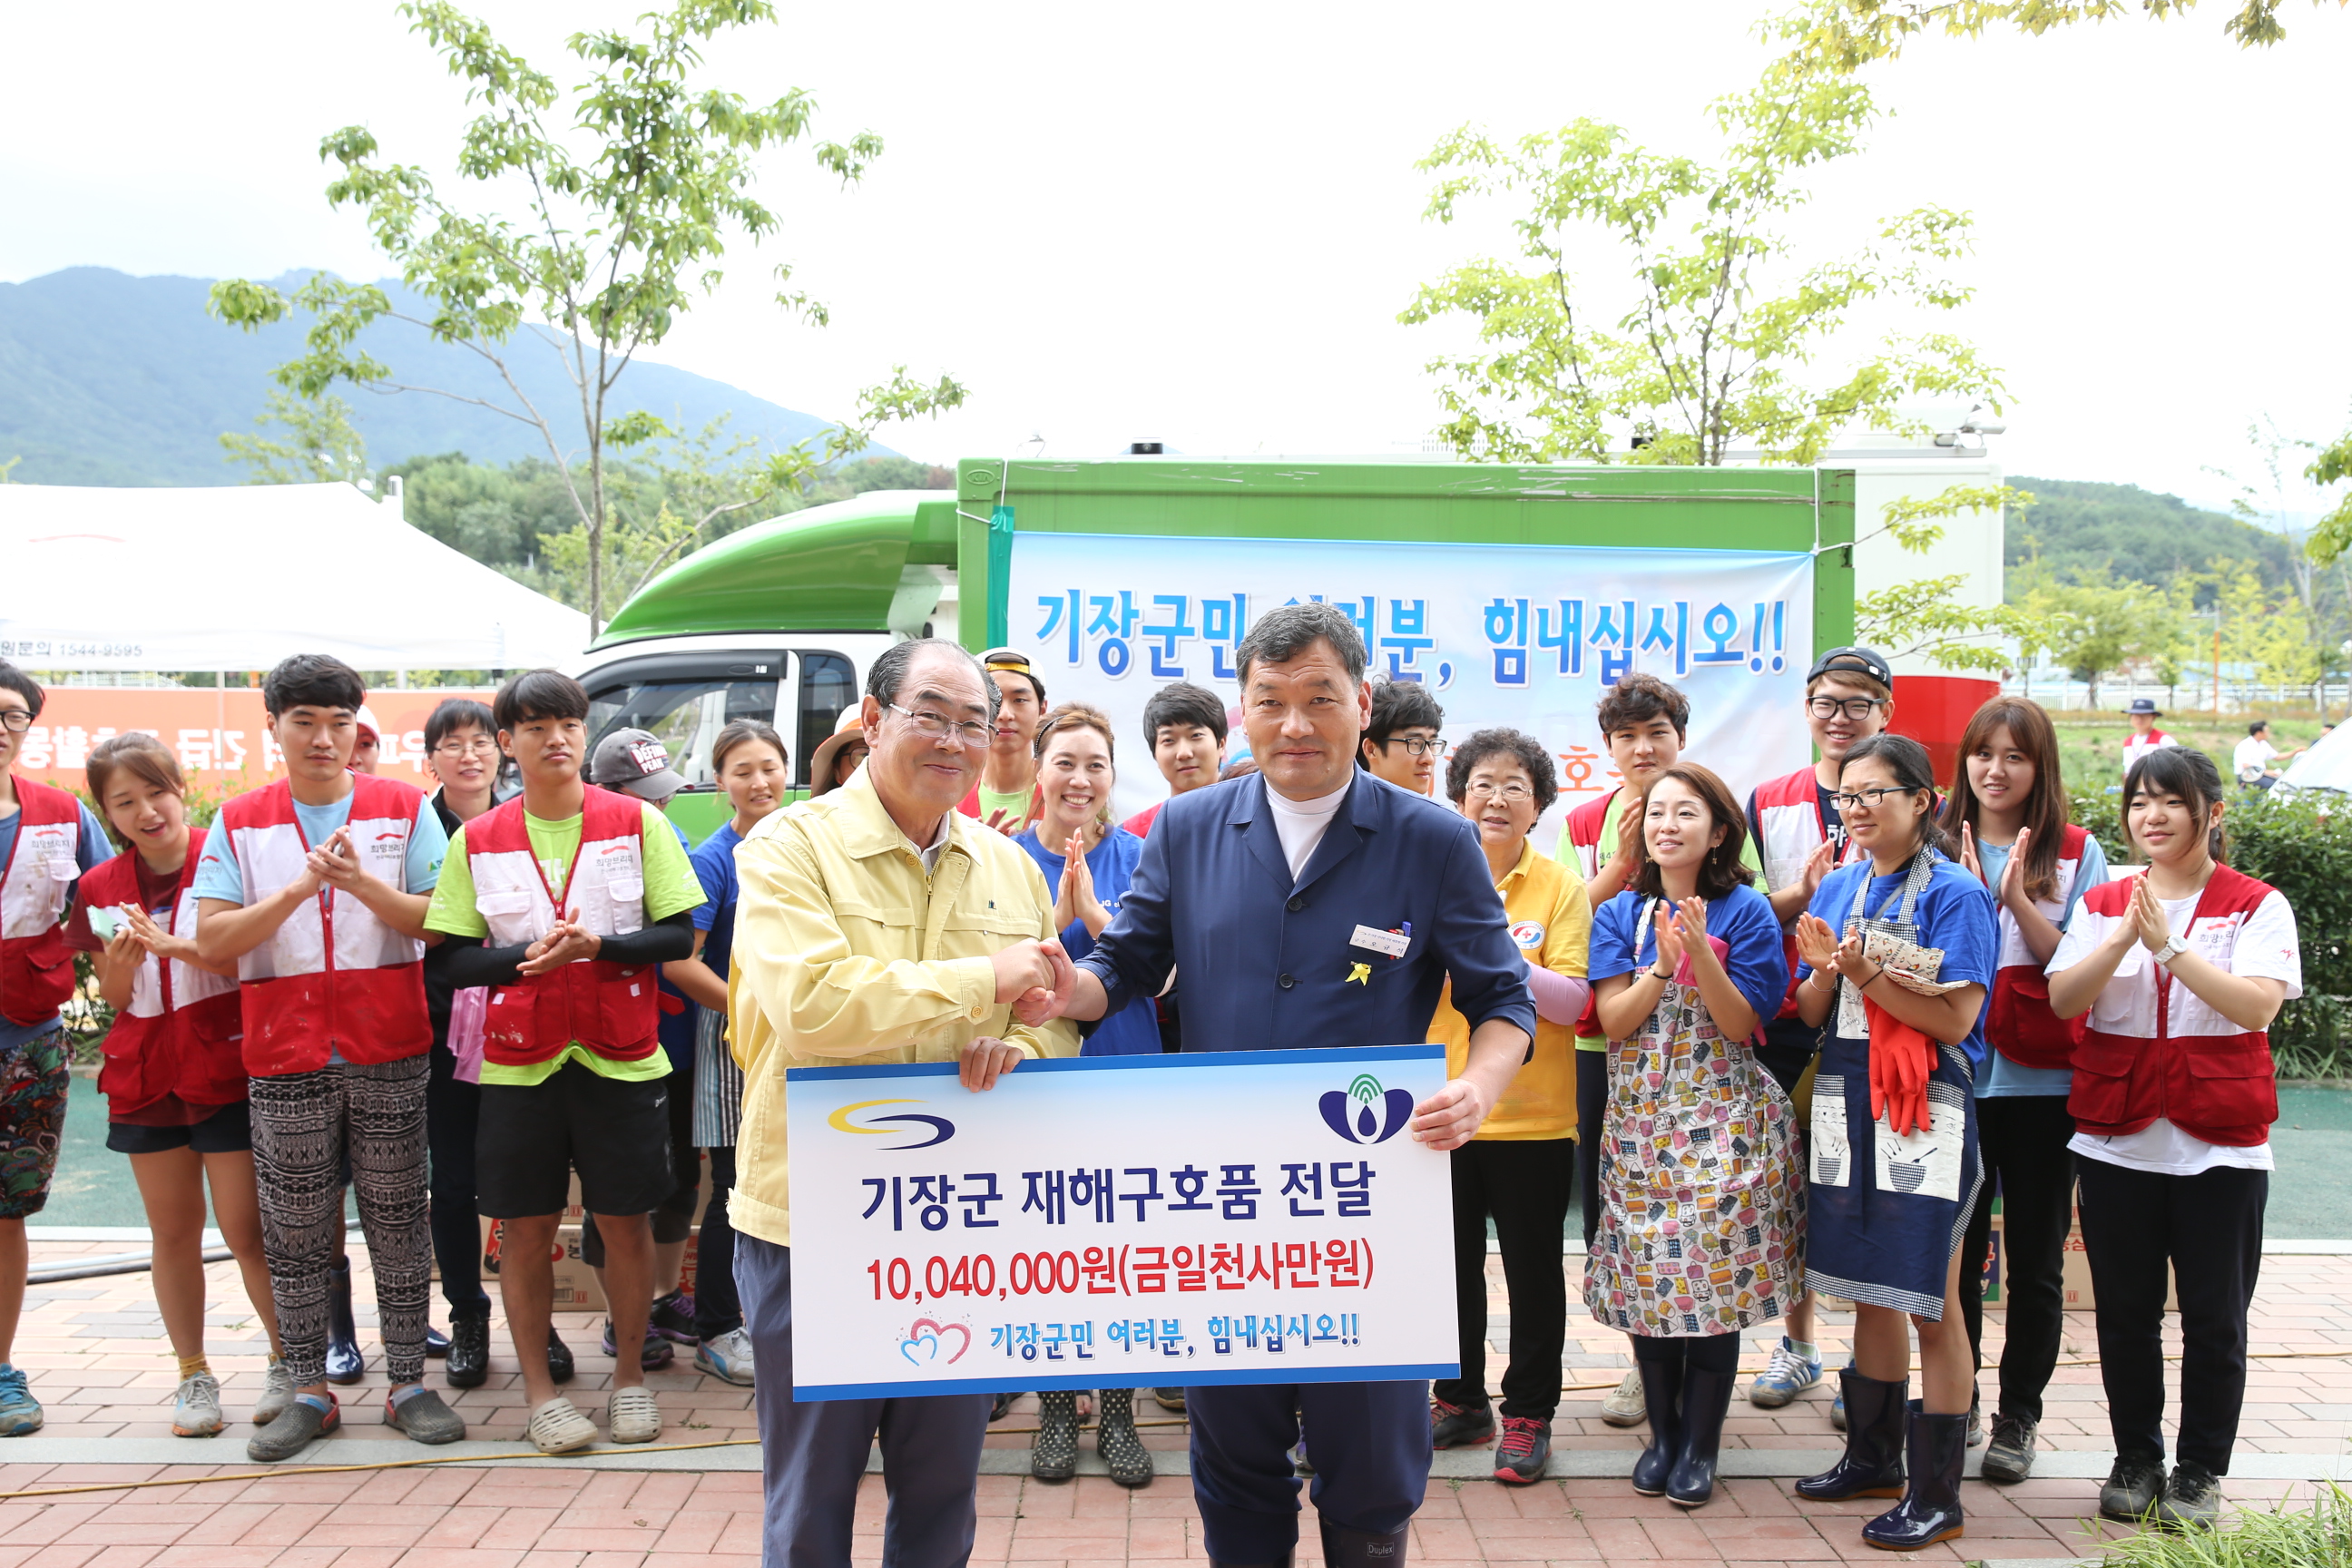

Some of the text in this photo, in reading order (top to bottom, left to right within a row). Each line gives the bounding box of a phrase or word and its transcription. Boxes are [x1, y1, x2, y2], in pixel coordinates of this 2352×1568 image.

[1036, 589, 1246, 679] 기장군민
[1484, 598, 1786, 686] 힘내십시오!!
[862, 1161, 1376, 1231] 기장군 재해구호품 전달
[867, 1237, 1374, 1305] 10,040,000원(금일천사만원)
[990, 1313, 1359, 1361] 기장군민 여러분, 힘내십시오!!
[1368, 1544, 1393, 1555] Duplex
